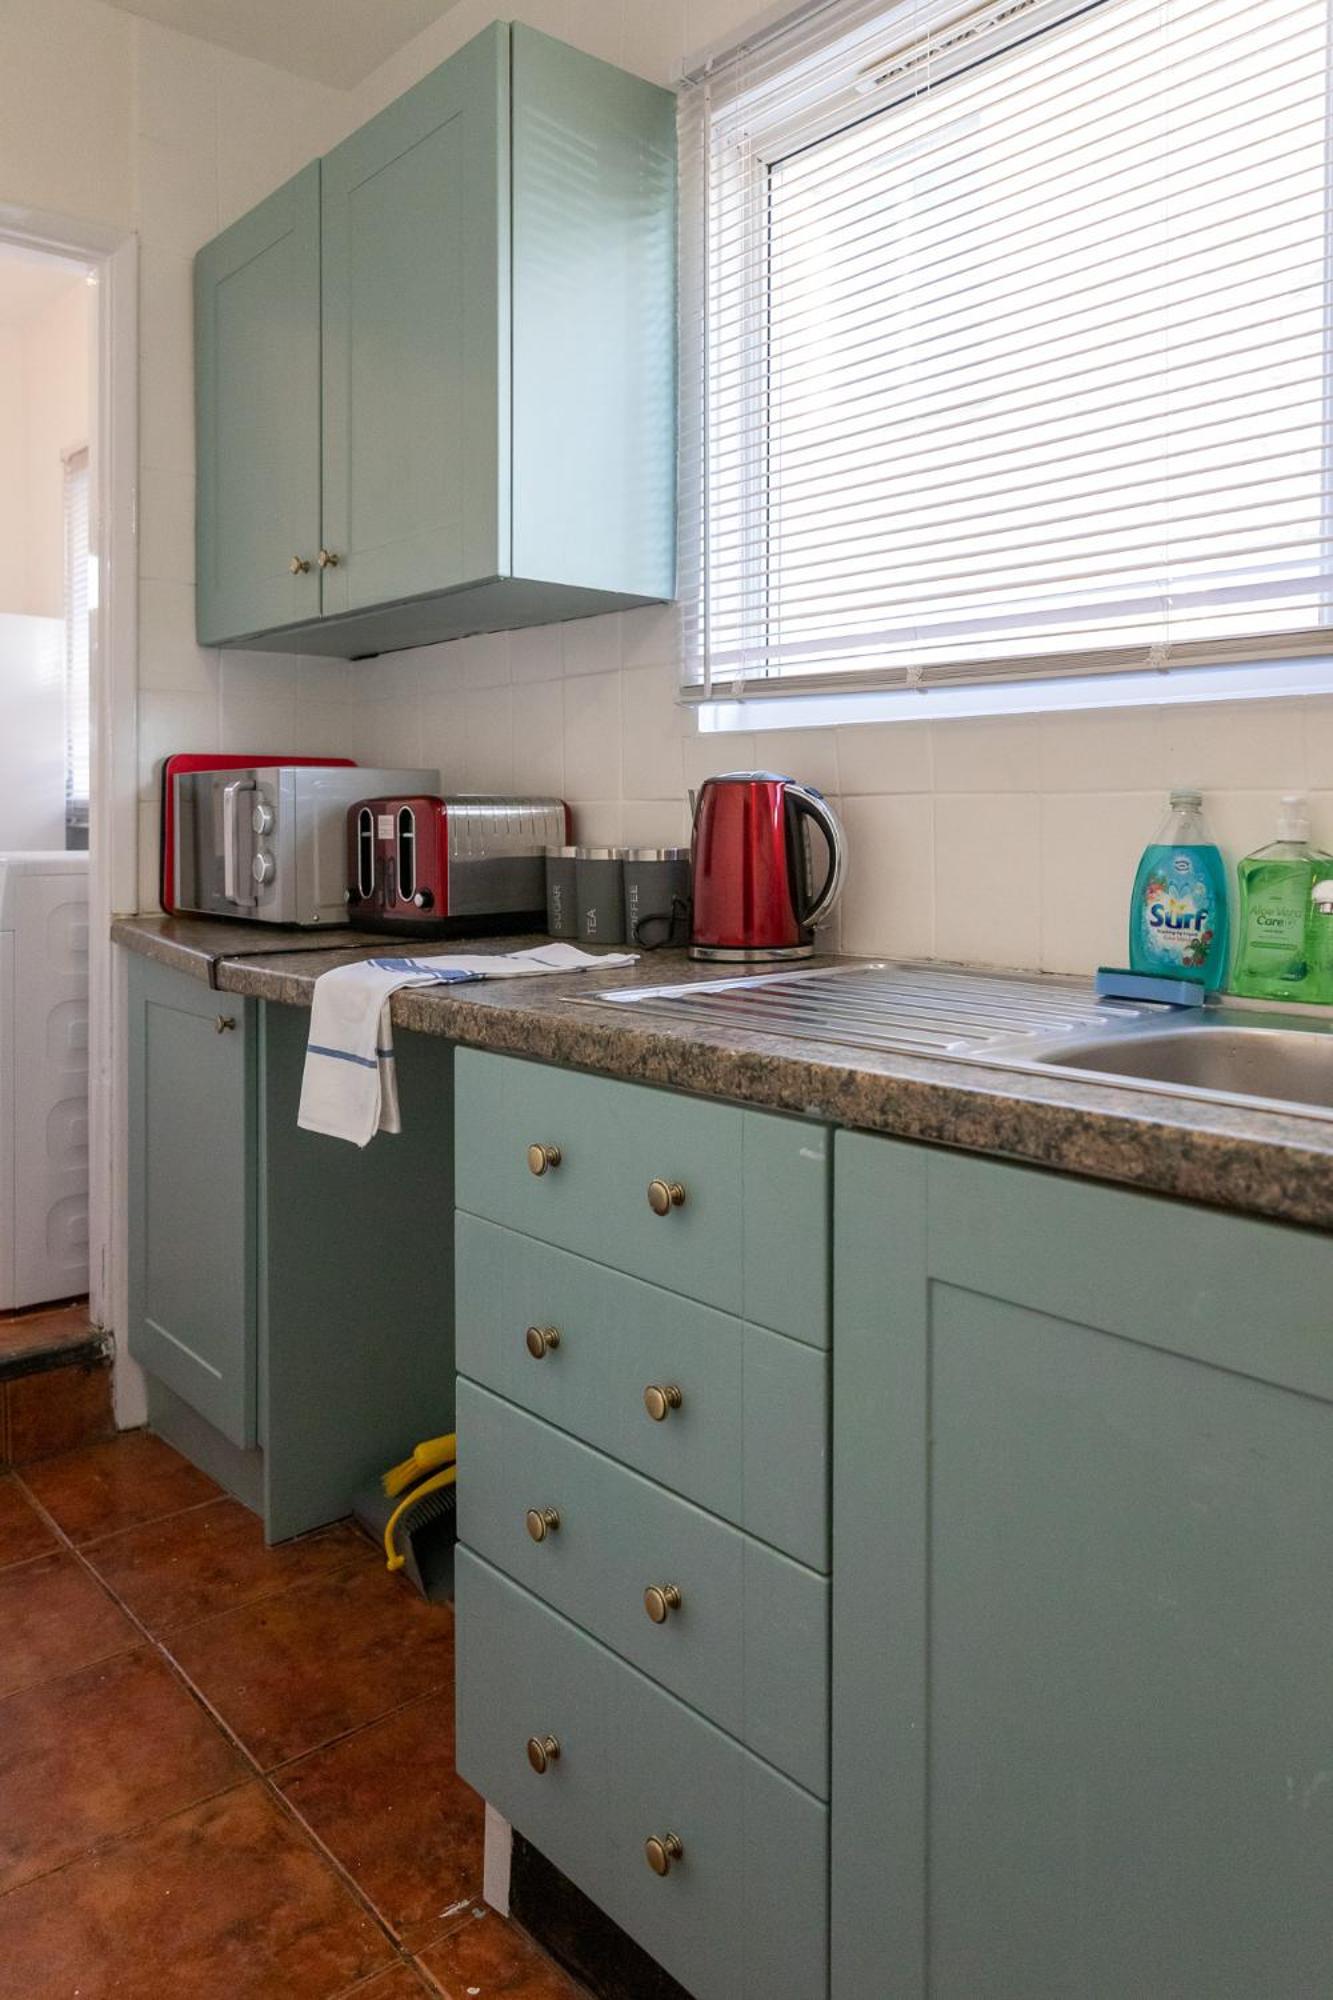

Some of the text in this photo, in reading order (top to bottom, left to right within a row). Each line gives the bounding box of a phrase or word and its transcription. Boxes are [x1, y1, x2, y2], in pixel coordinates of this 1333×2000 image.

[552, 885, 562, 929] SUGAR
[1150, 903, 1209, 931] Surf
[1256, 915, 1284, 927] Care
[586, 908, 597, 936] TEA
